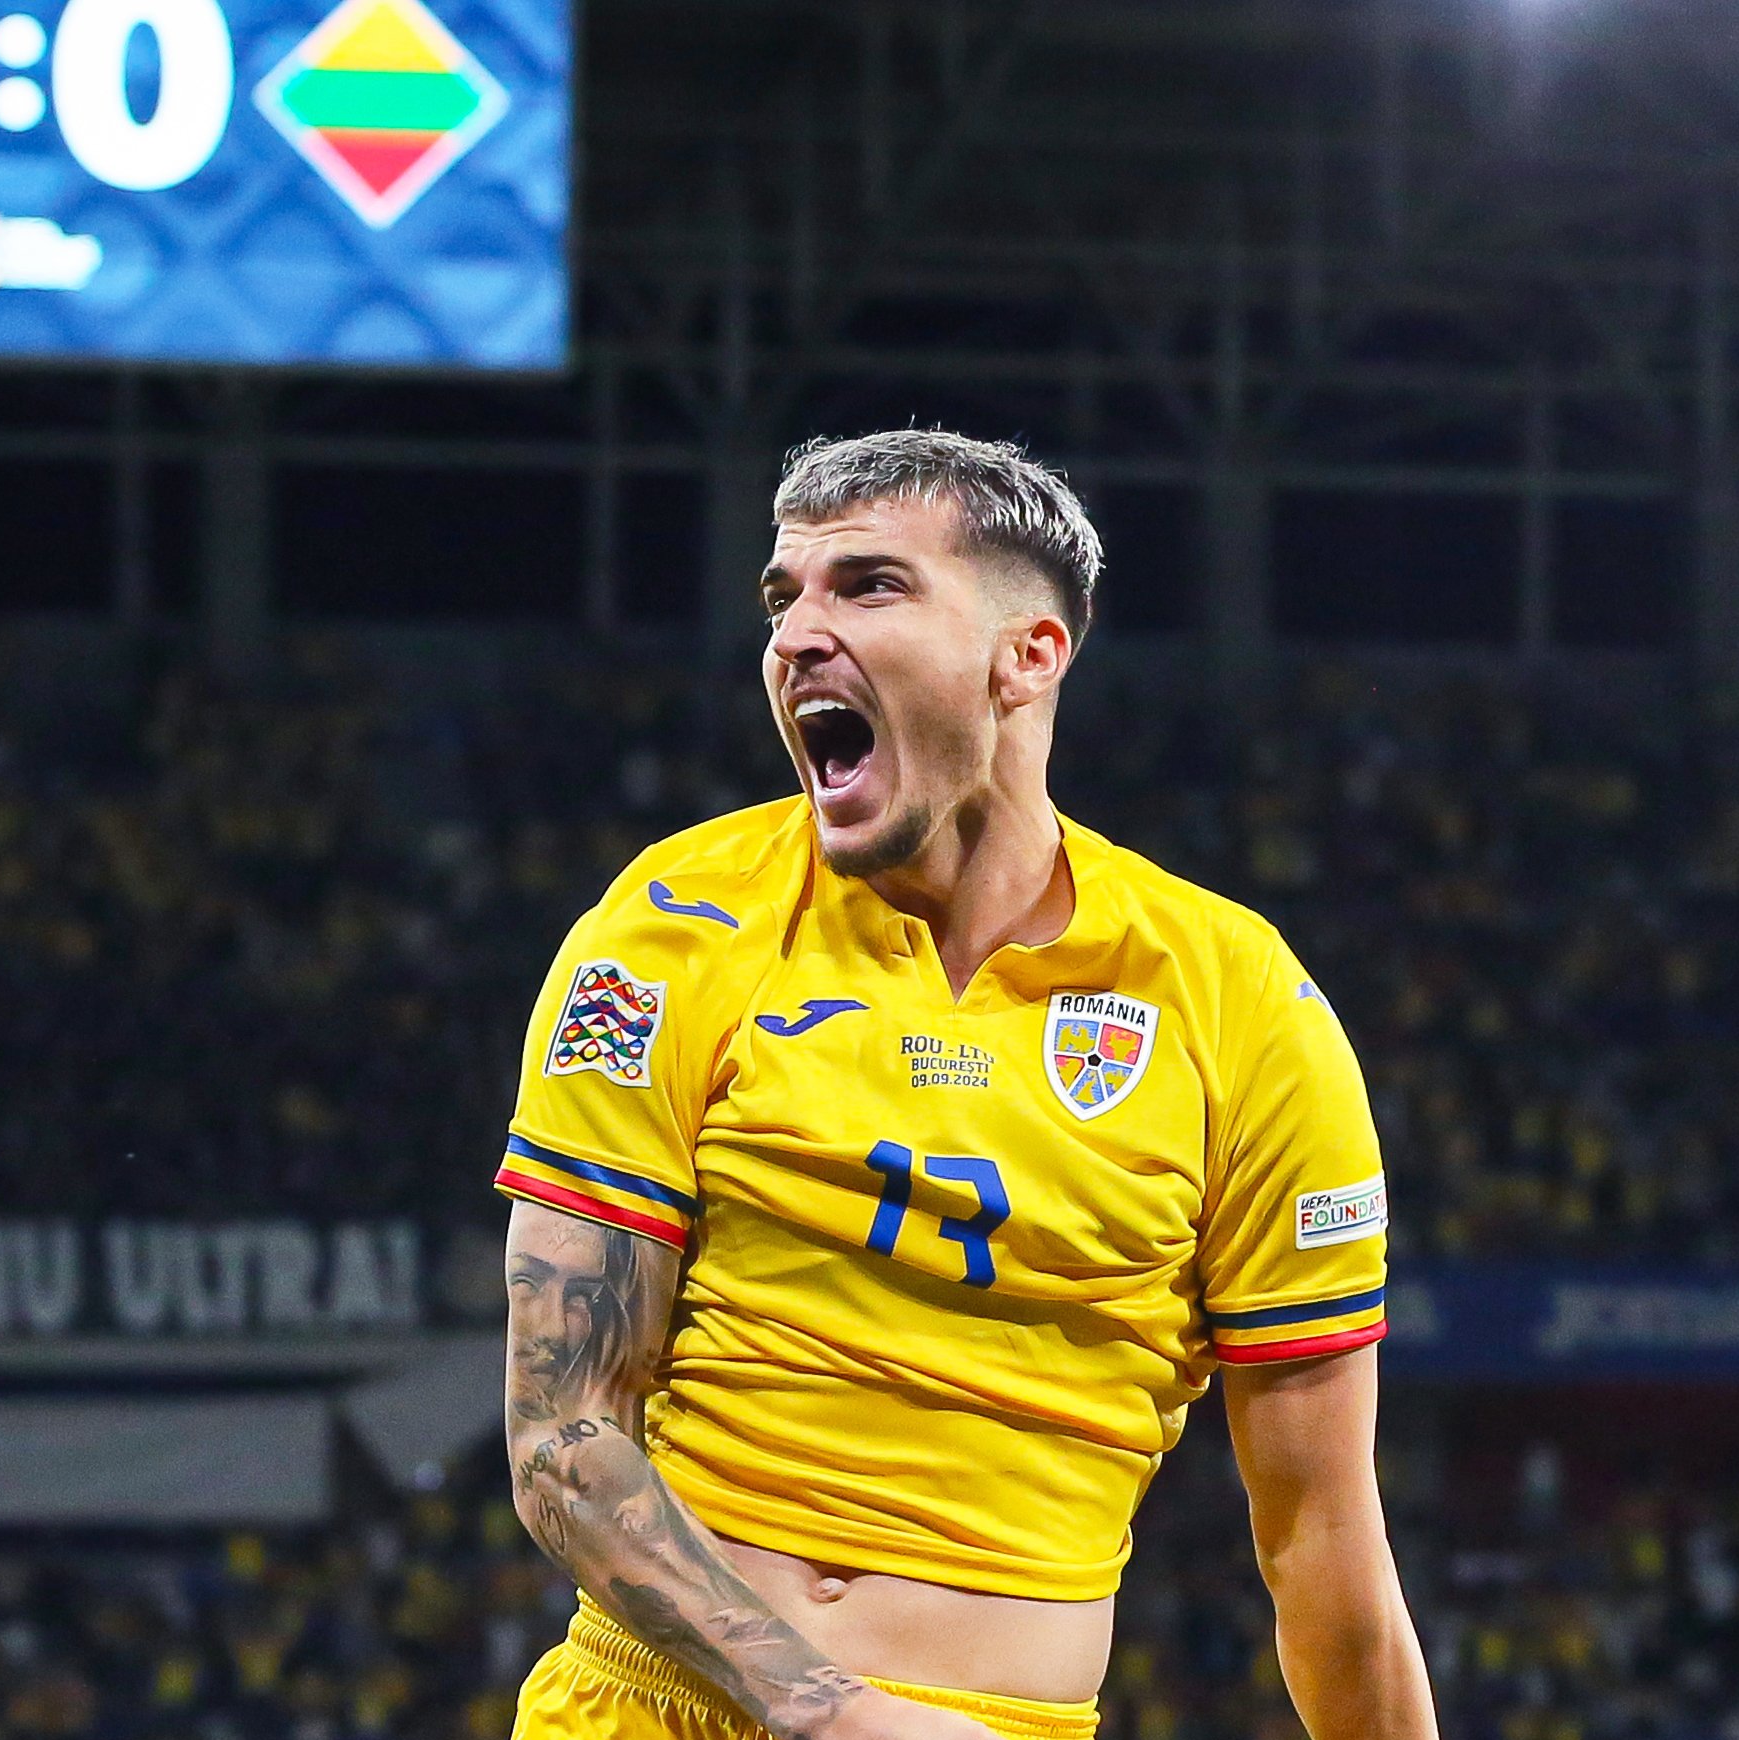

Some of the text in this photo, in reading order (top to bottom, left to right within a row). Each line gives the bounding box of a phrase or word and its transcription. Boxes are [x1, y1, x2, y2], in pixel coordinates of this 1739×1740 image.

[1060, 996, 1146, 1027] ROMÂNIA
[900, 1035, 943, 1055] ROU
[864, 1139, 1011, 1289] 13
[1300, 1194, 1332, 1211] UEFA
